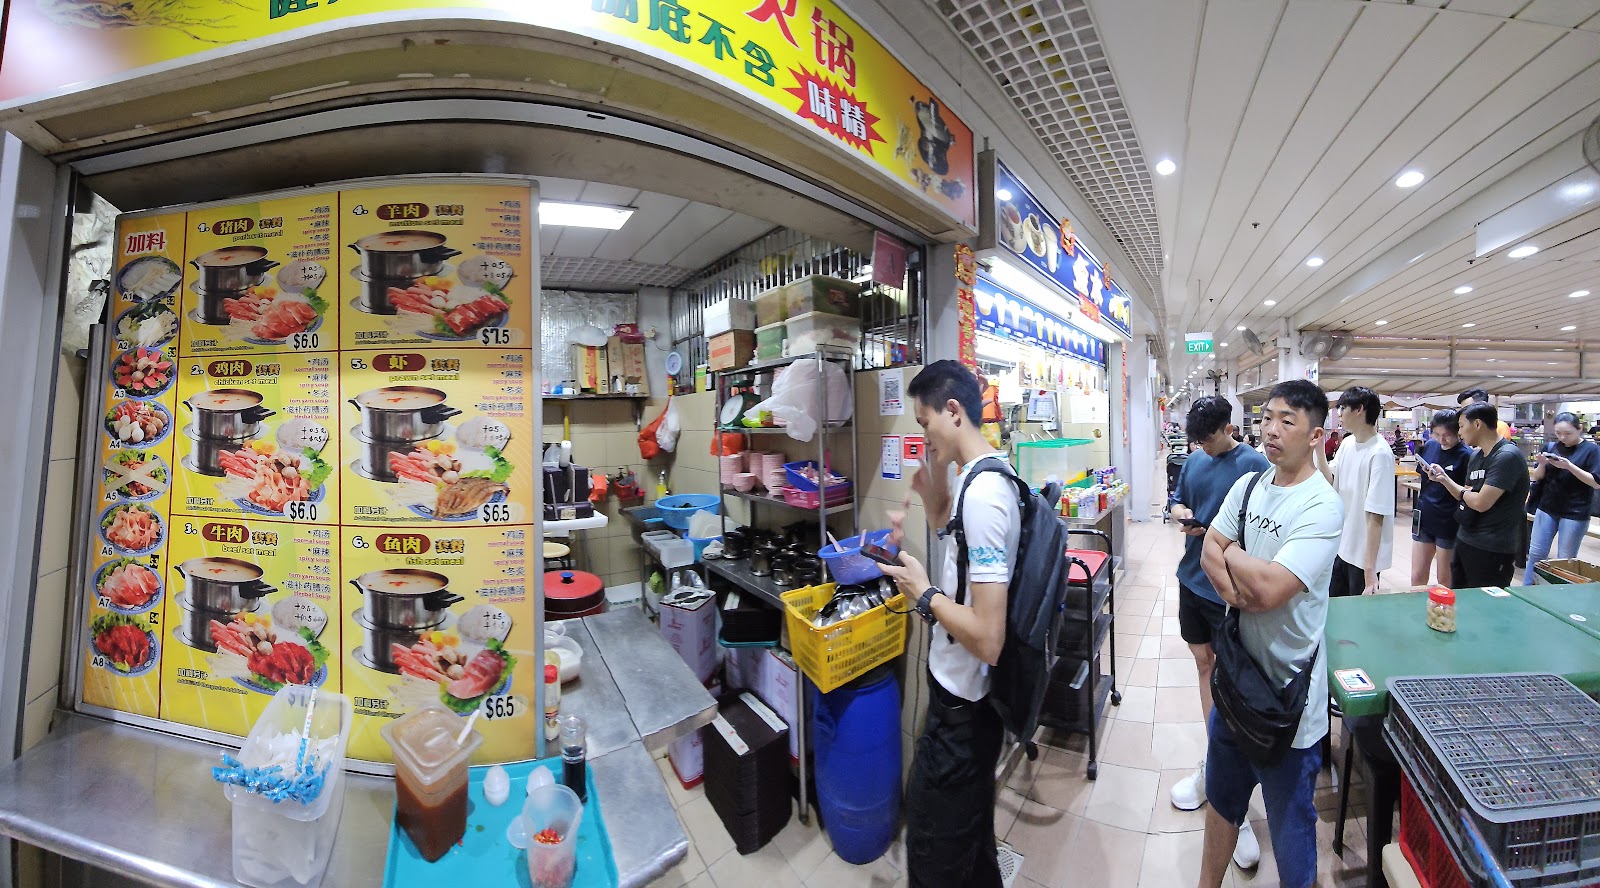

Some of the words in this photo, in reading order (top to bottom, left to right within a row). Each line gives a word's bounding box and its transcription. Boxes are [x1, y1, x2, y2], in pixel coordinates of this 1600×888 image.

[807, 80, 869, 141] 味精
[353, 204, 368, 216] 4.
[386, 204, 420, 218] 羊肉
[198, 222, 210, 232] 1.
[220, 220, 248, 234] 猪肉
[126, 231, 166, 253] 加料
[122, 292, 133, 300] A1
[293, 334, 318, 350] $6.0
[482, 328, 510, 346] $7.5
[118, 342, 128, 350] A2
[1188, 342, 1204, 352] EXIT
[190, 364, 204, 376] 2.
[214, 361, 244, 375] 鸡肉
[351, 358, 367, 370] 5.
[389, 355, 408, 370] 虾
[114, 389, 125, 398] A3
[109, 440, 121, 448] A4
[106, 492, 117, 500] A5
[290, 501, 317, 521] $6.0
[483, 504, 510, 524] $6.5
[184, 522, 197, 534] 3.
[210, 525, 242, 542] 牛肉
[252, 531, 278, 546] 套餐
[102, 547, 113, 556] A6
[222, 544, 241, 554] beef
[256, 548, 276, 556] meal
[352, 536, 370, 548] 6.
[383, 536, 421, 554] 鱼肉
[435, 539, 464, 553] 套餐
[313, 565, 330, 574] 冬炎
[99, 598, 110, 608] A7
[92, 656, 104, 666] A8
[486, 696, 514, 720] $6.5
